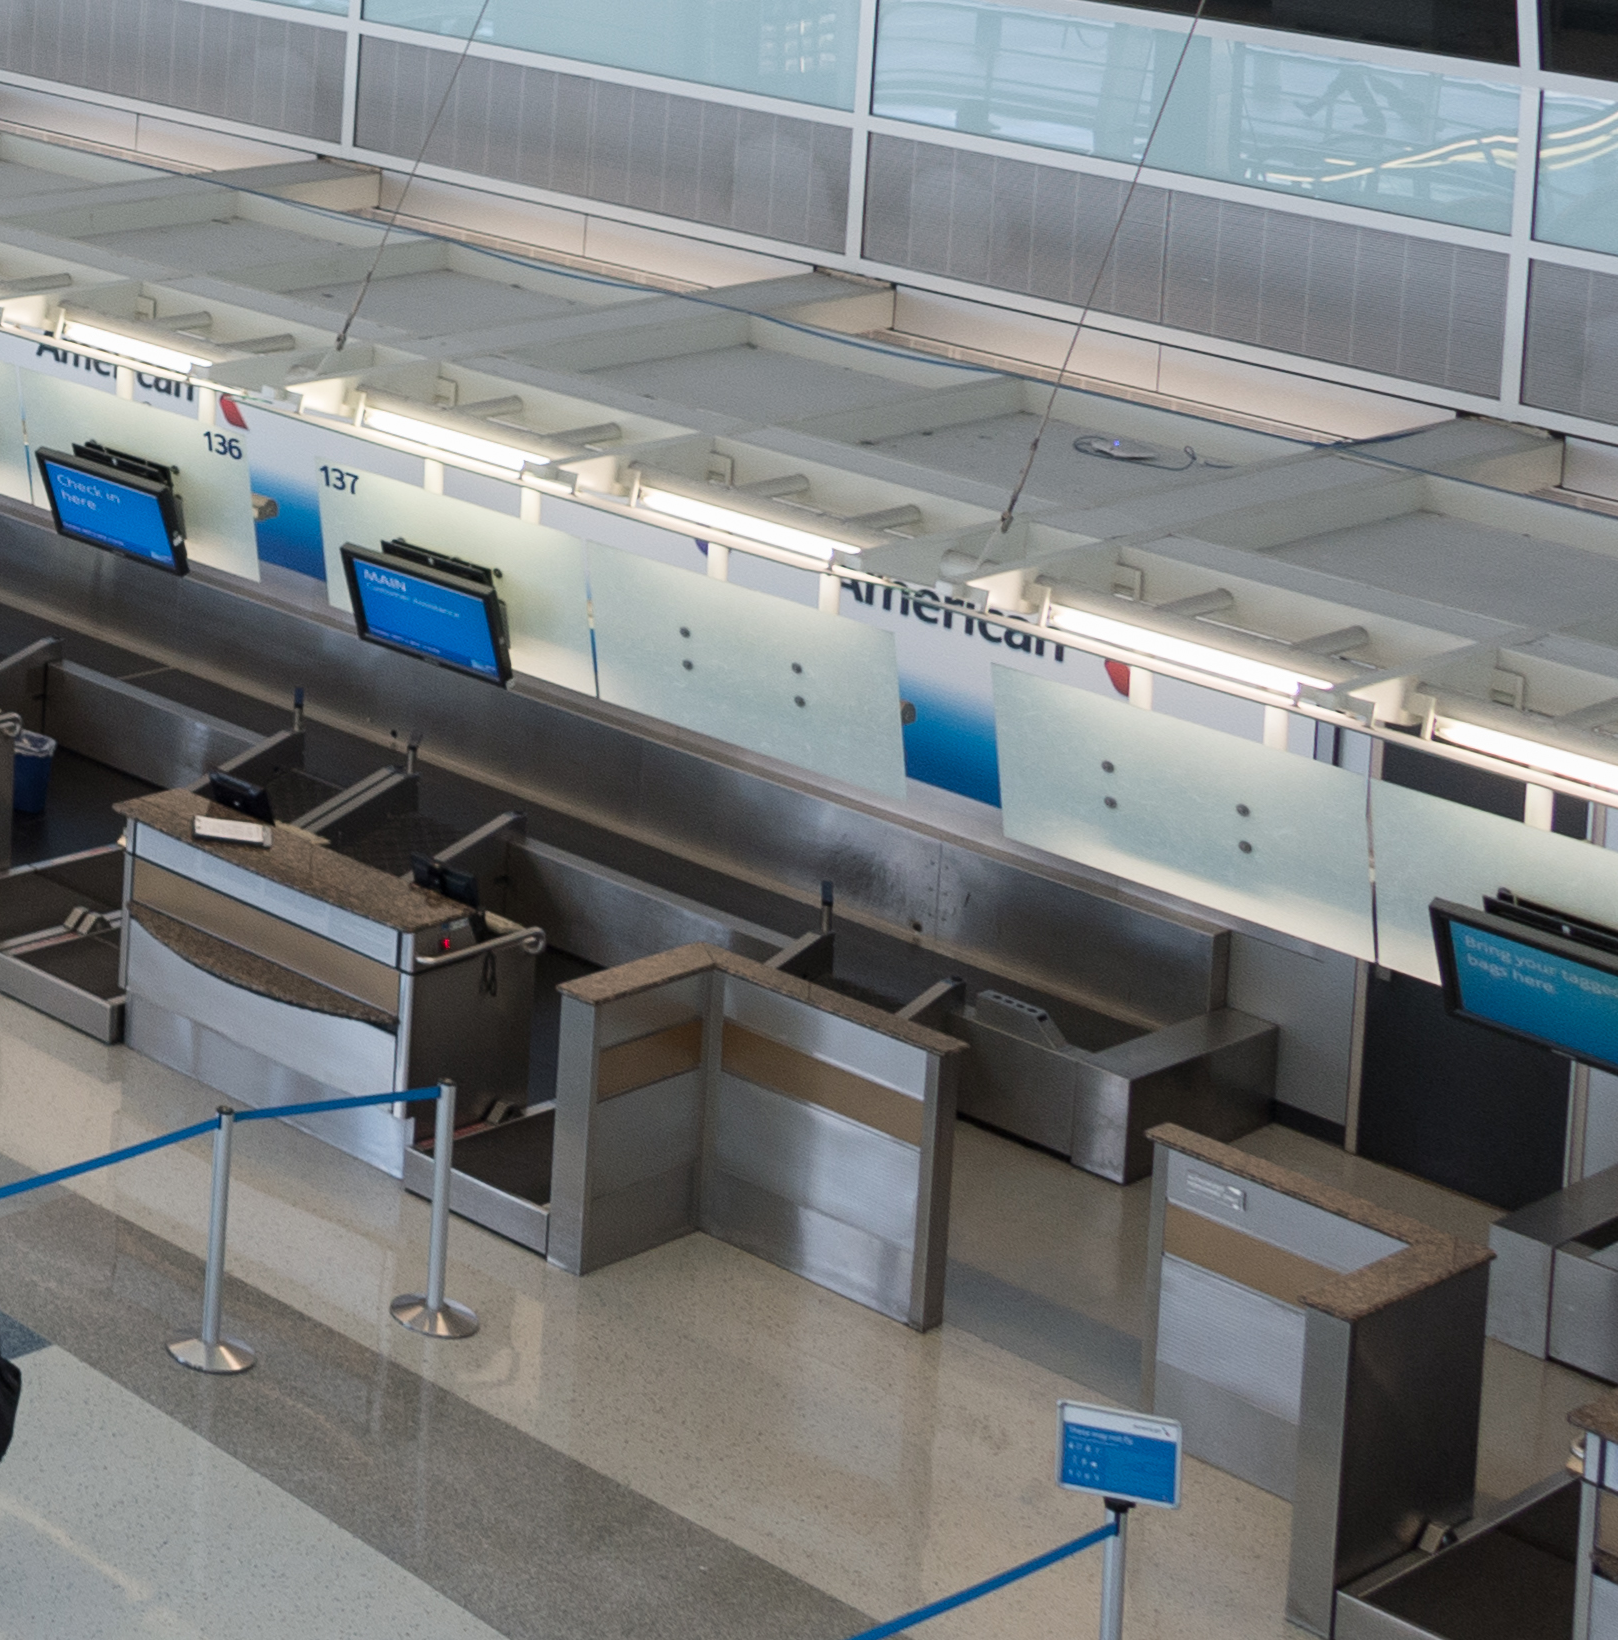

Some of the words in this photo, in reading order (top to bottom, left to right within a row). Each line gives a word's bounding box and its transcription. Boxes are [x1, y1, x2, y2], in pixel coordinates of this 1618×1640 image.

[203, 431, 243, 460] 136
[57, 473, 103, 500] Check
[106, 492, 121, 504] in
[319, 465, 360, 495] 137
[364, 568, 407, 592] MAIN
[1465, 934, 1513, 964] Bring
[1514, 955, 1557, 977] your
[1467, 952, 1509, 979] bags
